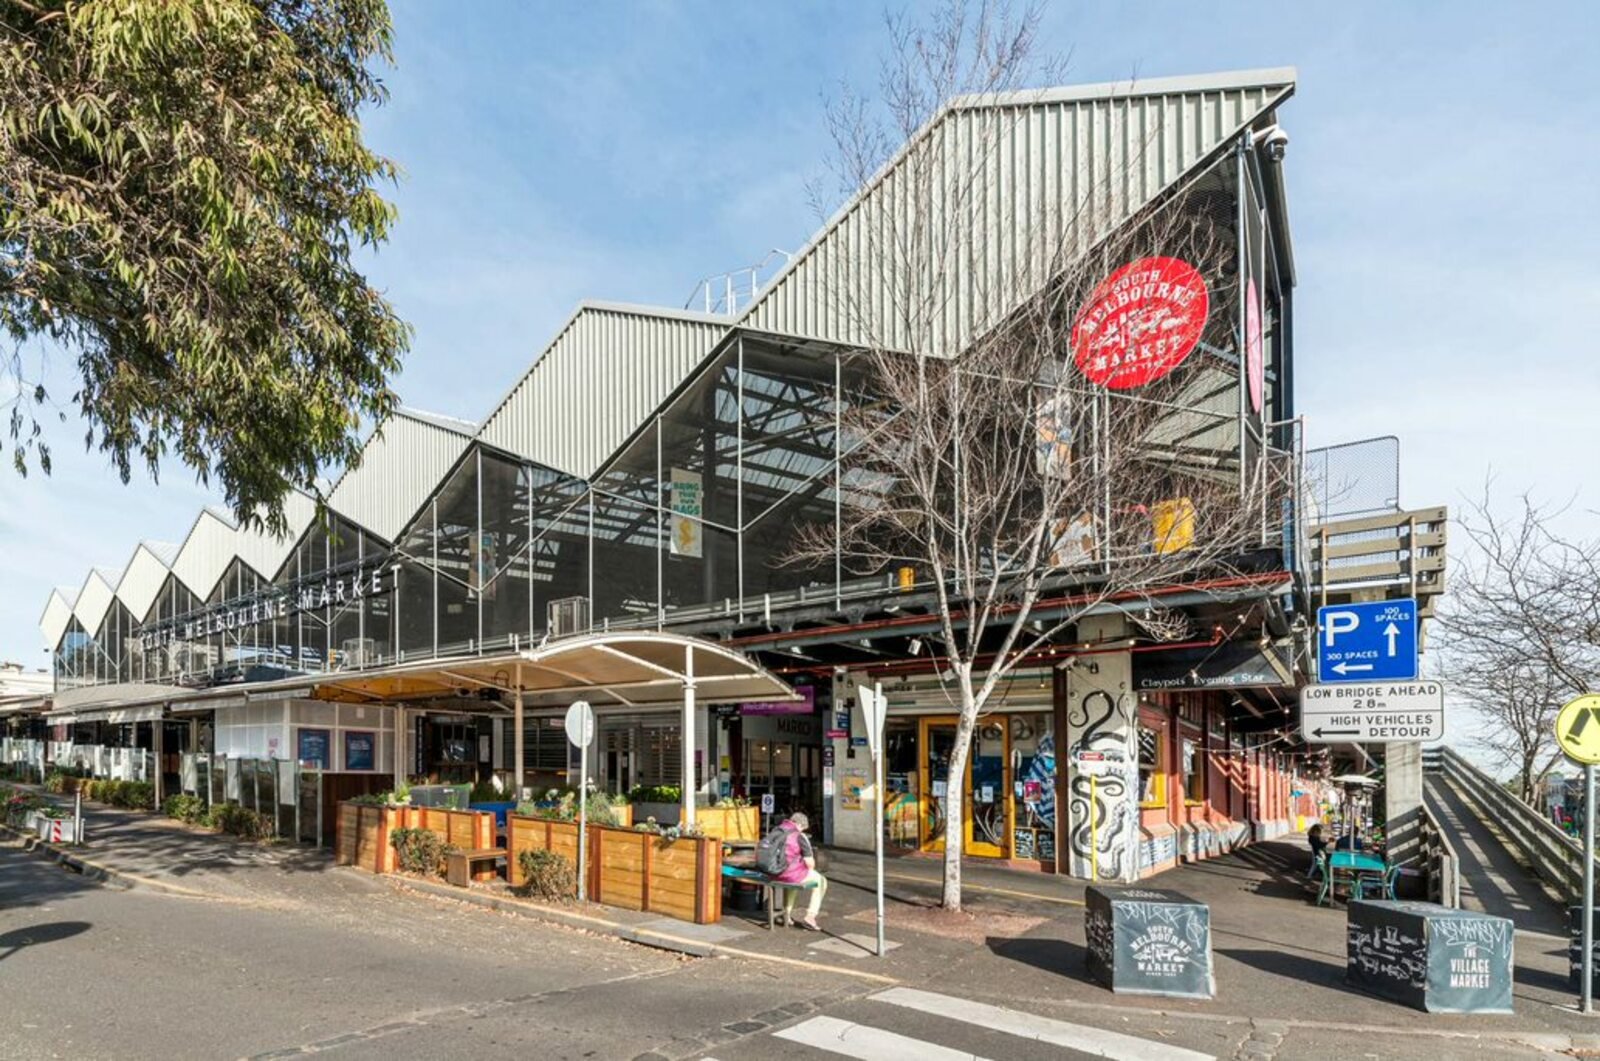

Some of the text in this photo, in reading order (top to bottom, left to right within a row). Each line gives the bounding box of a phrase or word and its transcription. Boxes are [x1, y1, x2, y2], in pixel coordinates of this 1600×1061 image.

[1111, 270, 1160, 295] SOUTH
[1082, 282, 1196, 334] MELBOURNE
[1095, 335, 1182, 371] MARKET
[186, 596, 286, 640] MELBOURNE
[302, 564, 402, 610] MARKET
[1384, 606, 1399, 614] 100
[1375, 612, 1410, 622] SPACES
[1325, 611, 1360, 647] P
[1344, 650, 1378, 660] SPACES
[1241, 672, 1265, 682] Star
[1306, 685, 1437, 699] LOW BRIDGE AHEAD
[1330, 714, 1434, 726] HIGH VEHICLES
[1369, 727, 1431, 737] DETOUR
[1147, 925, 1175, 935] SOUTH
[1130, 932, 1192, 954] MELBOURNE
[1463, 946, 1477, 958] THE
[1138, 961, 1184, 973] MARKET
[1450, 958, 1491, 974] VILLAGE
[1450, 974, 1491, 988] MARKET
